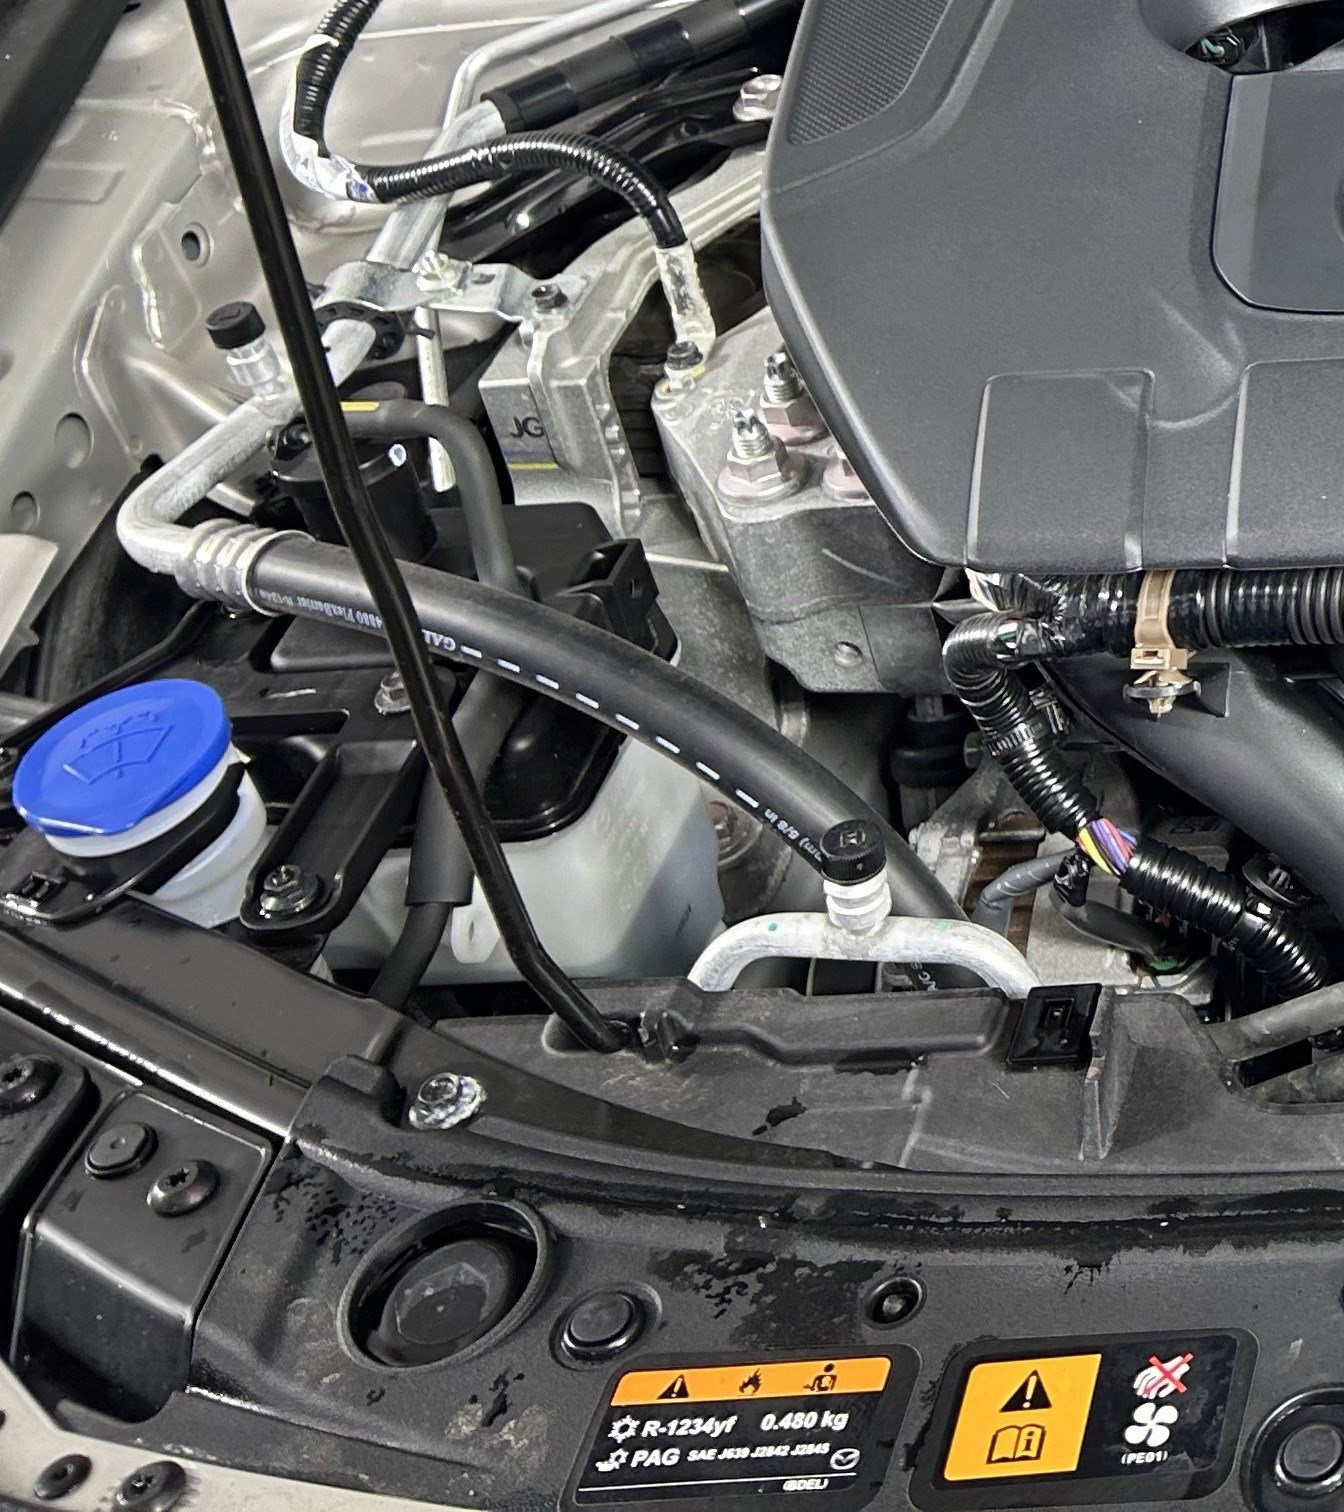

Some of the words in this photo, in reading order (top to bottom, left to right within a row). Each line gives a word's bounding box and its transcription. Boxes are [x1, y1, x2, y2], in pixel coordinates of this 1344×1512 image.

[421, 629, 456, 651] GAL
[641, 1414, 738, 1438] R-1234yf
[760, 1412, 816, 1431] 0.480
[820, 1411, 849, 1430] kg
[630, 1449, 681, 1467] PAG
[687, 1449, 718, 1461] SAE
